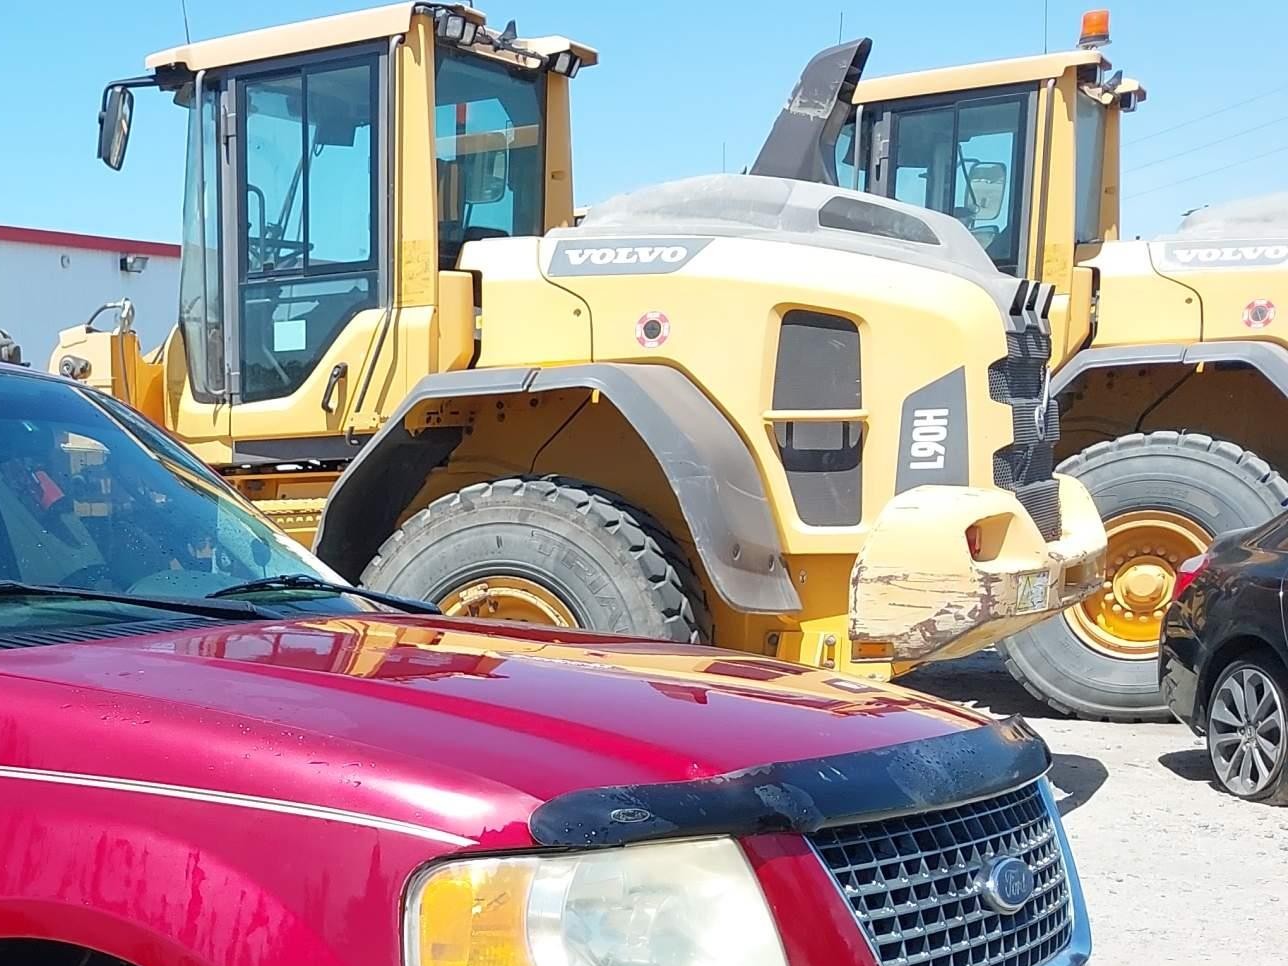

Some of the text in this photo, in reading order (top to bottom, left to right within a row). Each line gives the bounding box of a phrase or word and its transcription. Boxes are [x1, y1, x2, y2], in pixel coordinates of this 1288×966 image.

[564, 246, 688, 265] VOLVO
[1172, 245, 1288, 263] VOLVO
[908, 408, 949, 470] L90H
[1003, 867, 1029, 899] Ford
